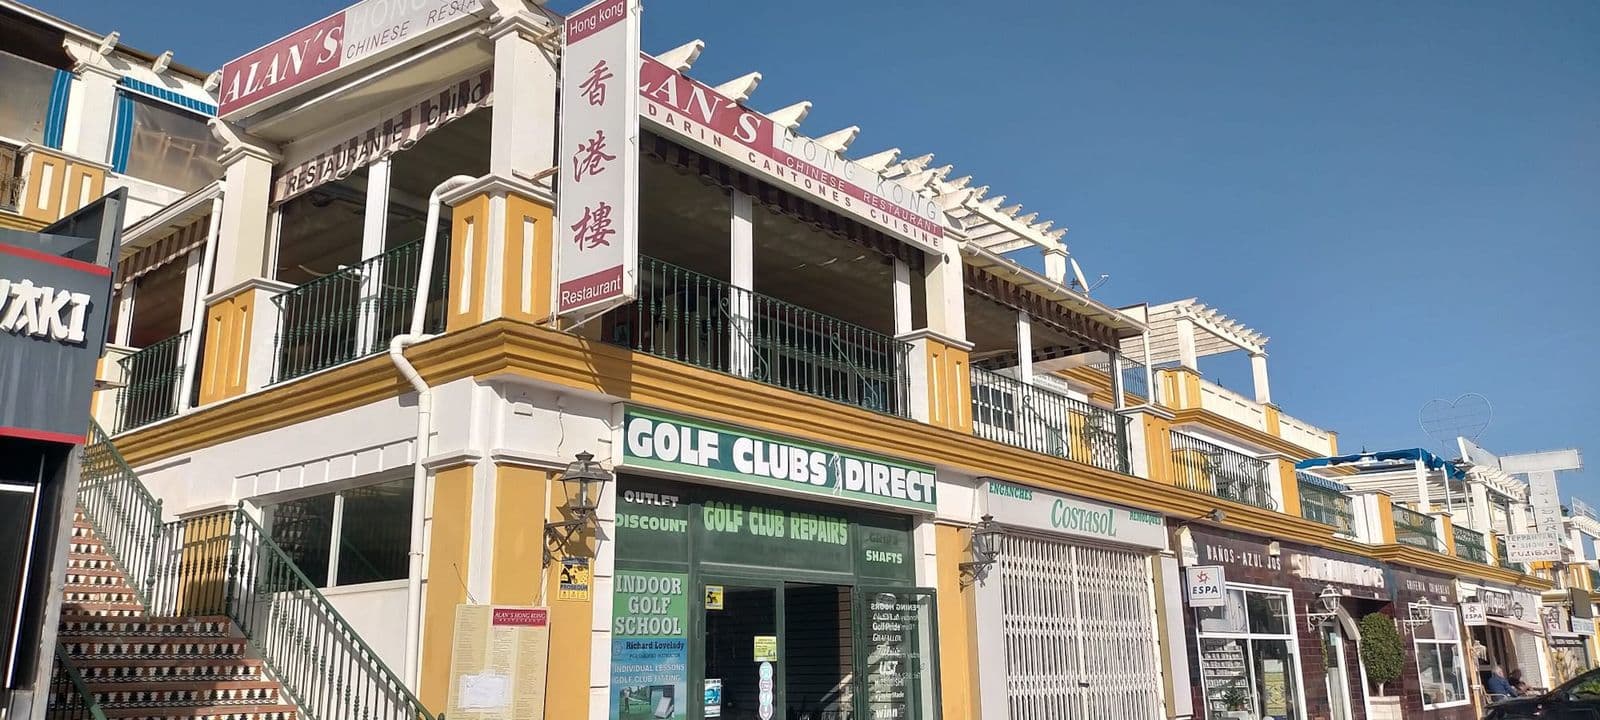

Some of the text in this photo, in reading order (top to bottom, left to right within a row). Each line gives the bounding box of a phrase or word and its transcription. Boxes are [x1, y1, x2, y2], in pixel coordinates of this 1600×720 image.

[570, 2, 624, 36] Hong kong
[346, 20, 410, 59] CHINESE
[221, 23, 343, 106] ALAN'S
[286, 77, 490, 195] RESTAURANTE CHINO
[571, 59, 616, 251] 香港樓
[782, 127, 856, 180] HONG
[748, 151, 851, 208] CANTONES
[870, 209, 939, 247] CUISINE
[786, 157, 942, 238] CHINESE RESTAURANT
[562, 275, 622, 306] Restaurant
[627, 418, 936, 503] GOLF CLUBS DIRECT
[624, 490, 679, 508] OUTLET
[989, 482, 1032, 501] ENGANCHES
[615, 512, 688, 532] DISCOUNT
[703, 500, 848, 545] GOLF CLUB REPAIRS
[865, 550, 902, 564] SHAFTS
[615, 574, 681, 595] INDOOR
[1192, 585, 1218, 595] ESPA
[628, 596, 671, 614] GOLF
[615, 616, 681, 635] SCHOOL
[626, 641, 685, 651] Richard Lovelady
[614, 663, 685, 673] INDIVIDUAL LESSONS
[876, 705, 898, 719] winn
